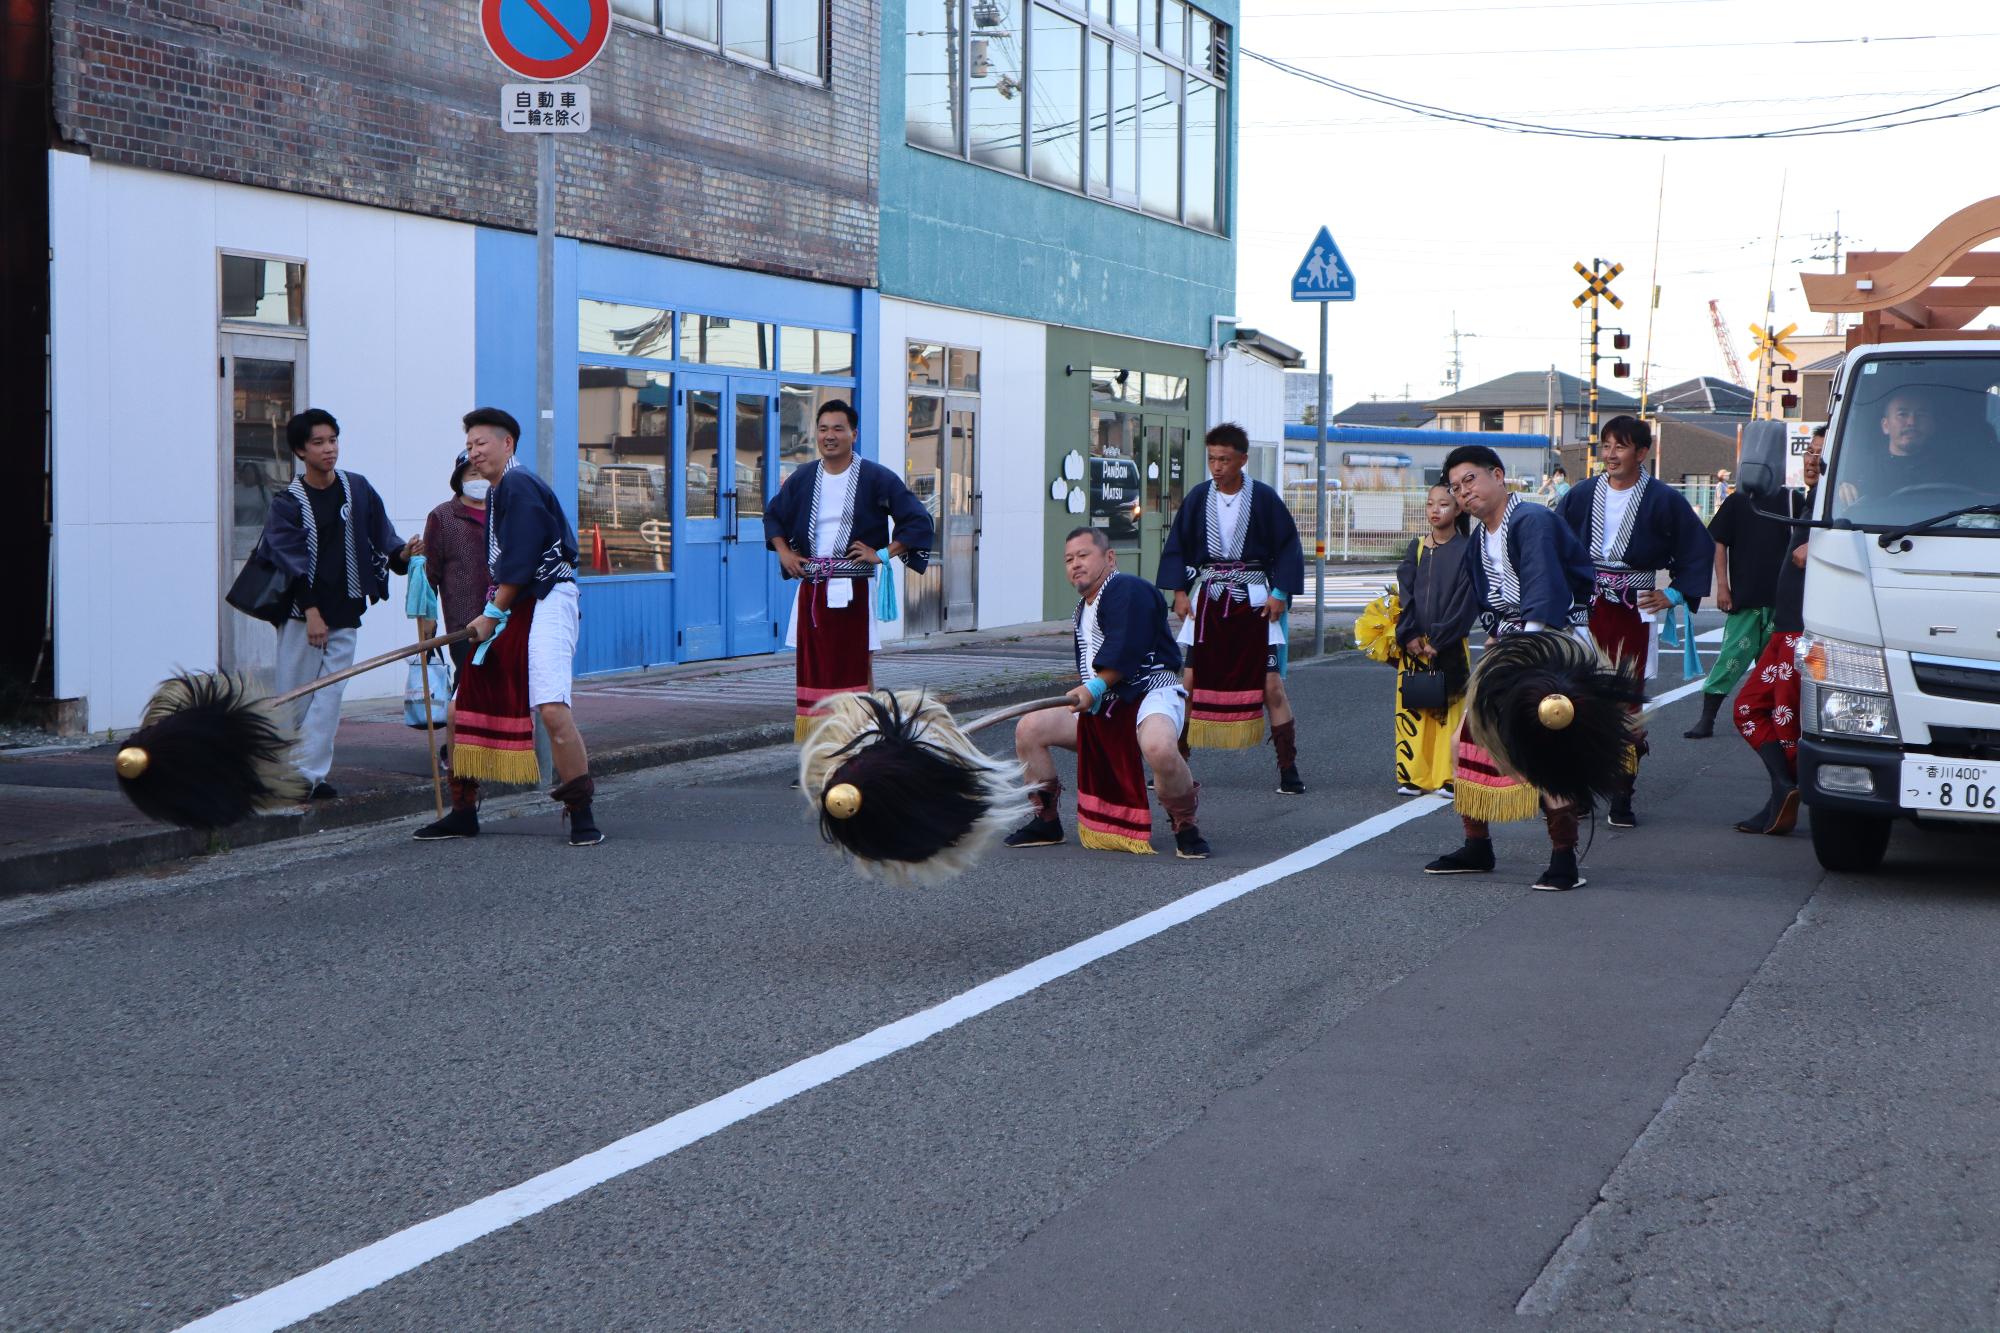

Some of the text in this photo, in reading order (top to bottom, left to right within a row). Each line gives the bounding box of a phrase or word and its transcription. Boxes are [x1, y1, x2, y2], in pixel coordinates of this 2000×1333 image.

[516, 91, 576, 108] 自動車
[1926, 765, 1980, 780] 香川400
